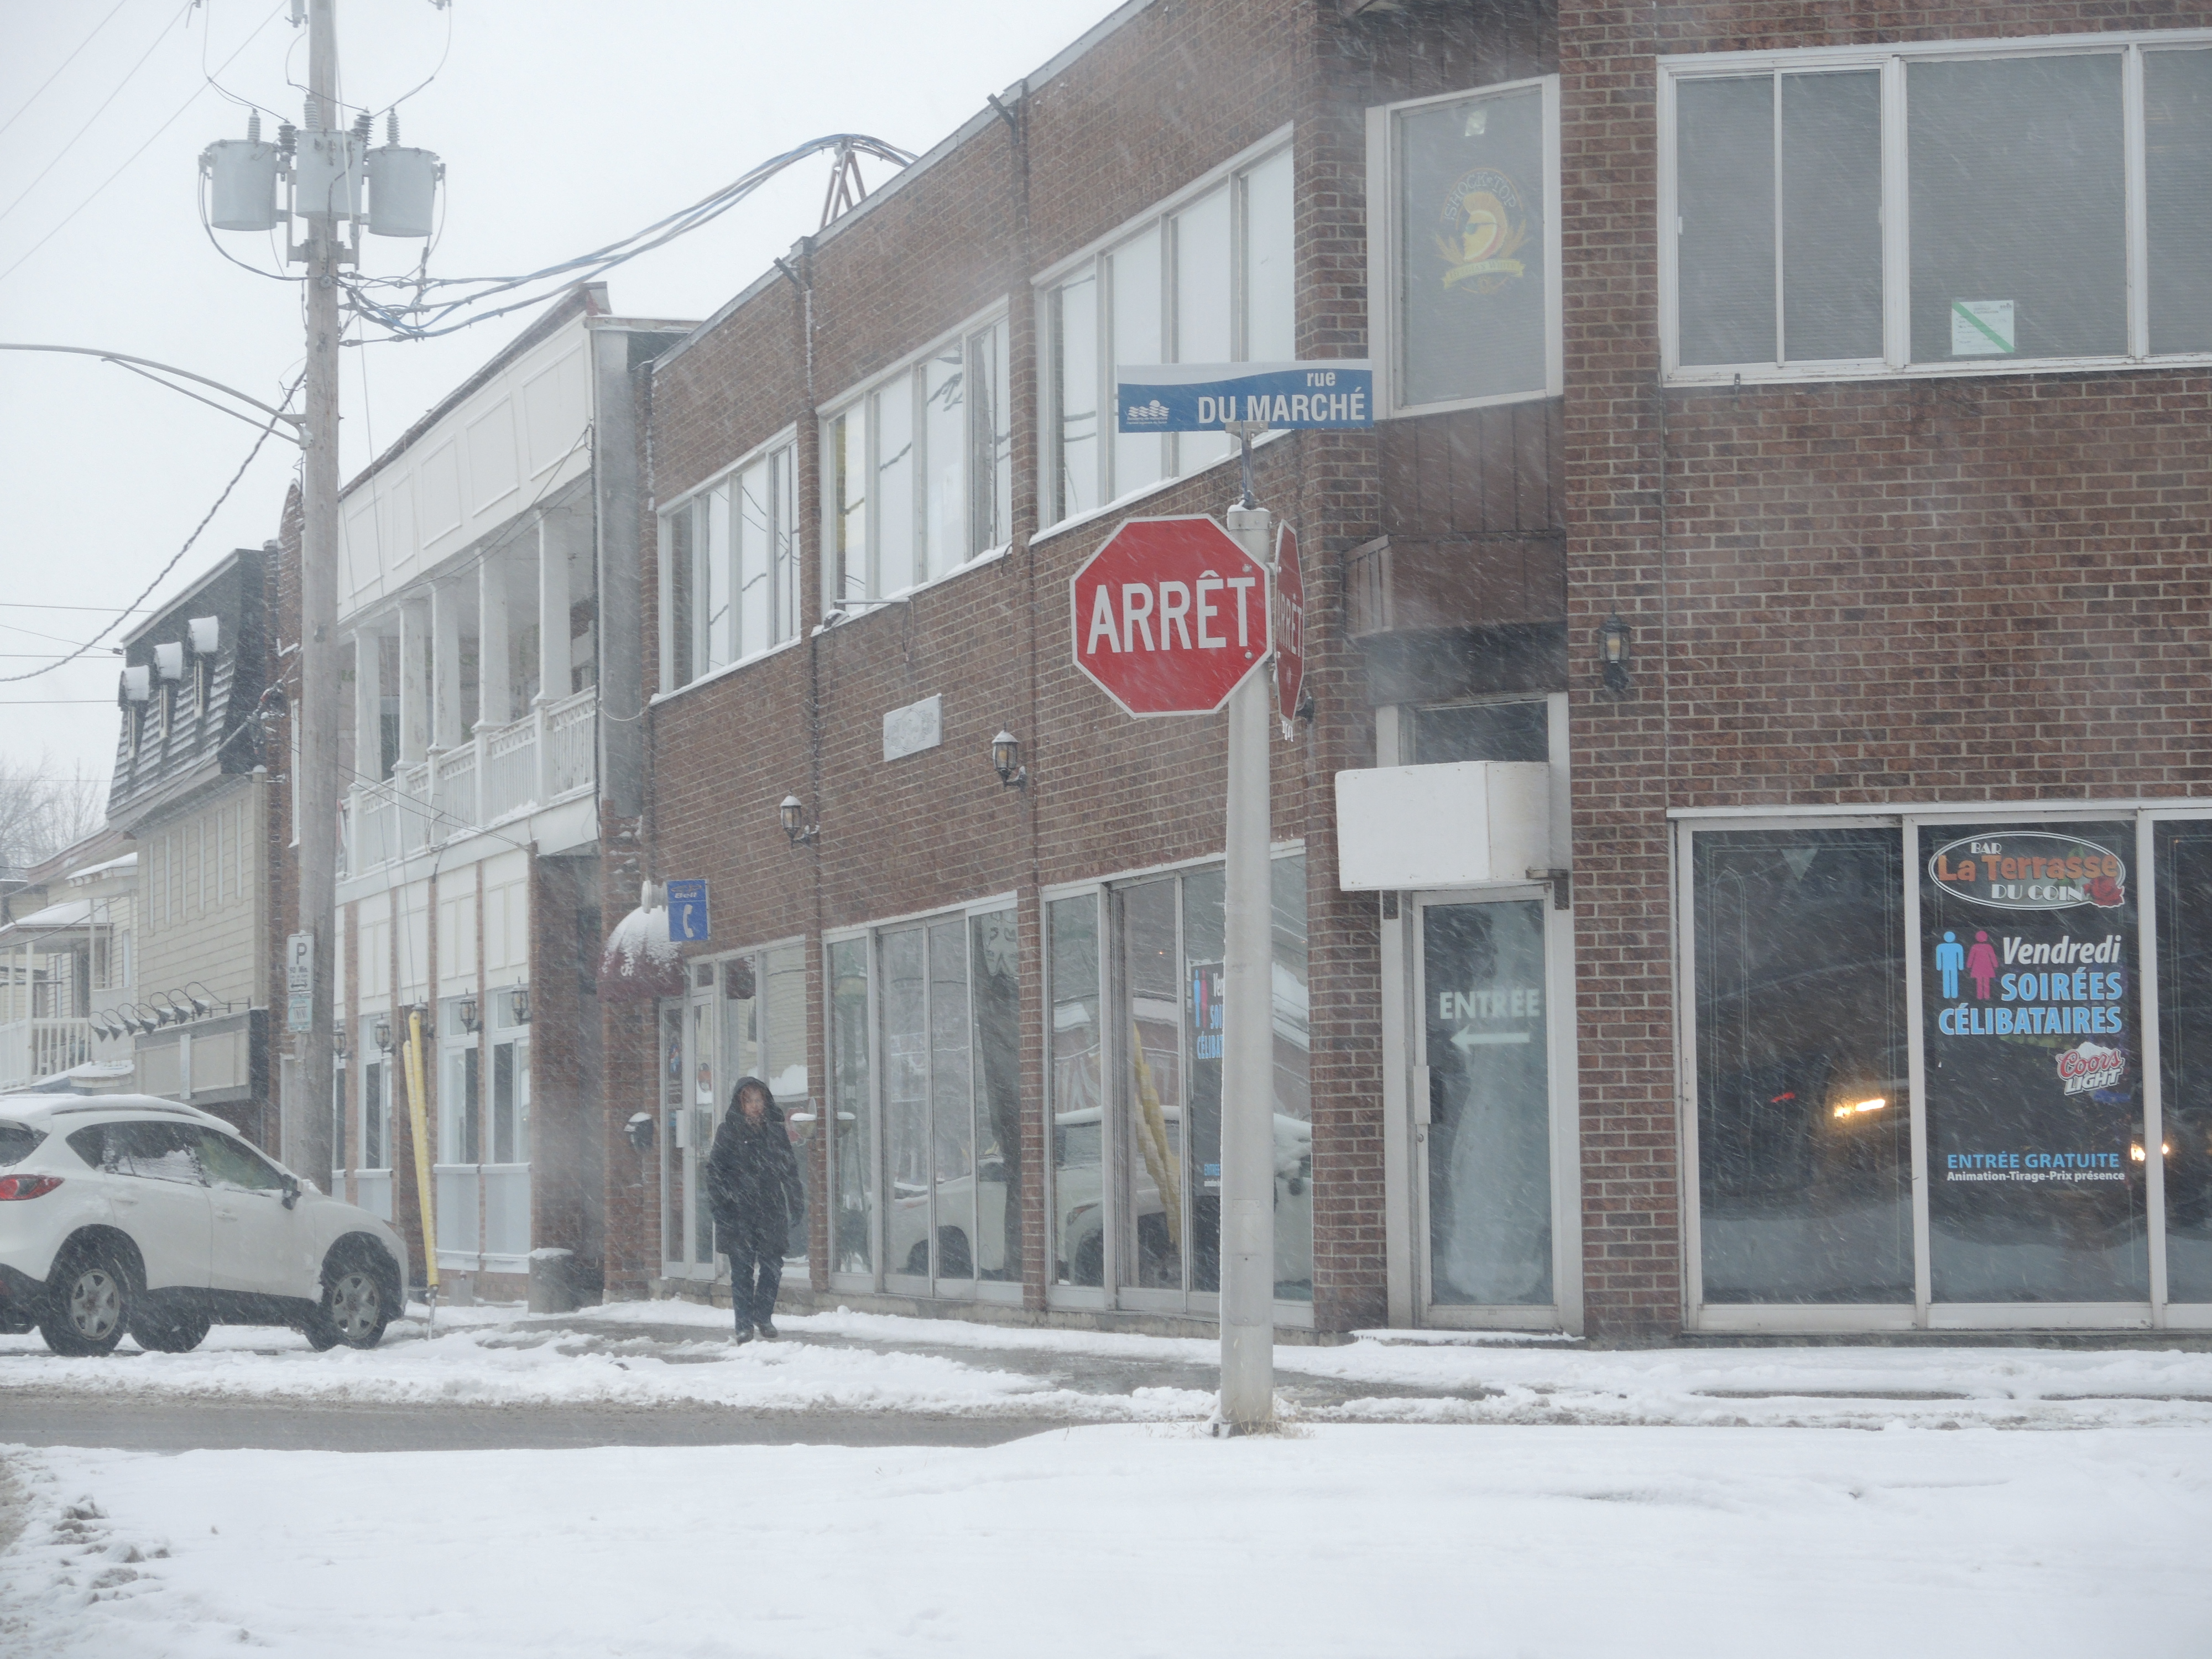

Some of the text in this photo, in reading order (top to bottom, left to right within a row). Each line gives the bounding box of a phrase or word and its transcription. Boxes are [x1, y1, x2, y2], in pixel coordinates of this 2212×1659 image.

[1307, 372, 1336, 387] rue
[1198, 387, 1365, 424] DU MARCHÉ
[1087, 570, 1255, 654] ARRÊT
[1970, 842, 2002, 855] BAR
[1938, 854, 2117, 881] La Terrasse
[1991, 884, 2084, 902] DU COIN
[296, 942, 307, 964] P
[2002, 935, 2122, 964] Vendredi
[2001, 967, 2122, 1001] SOIRÉES
[1938, 1003, 2122, 1035] CÉLIBATAIRES
[2056, 1048, 2125, 1080] Coors
[2064, 1068, 2122, 1095] LIGHT
[1947, 1151, 2120, 1168] ENTRÉE GRATUITE
[1947, 1171, 2125, 1183] Animation-Tirage-Prix présence
